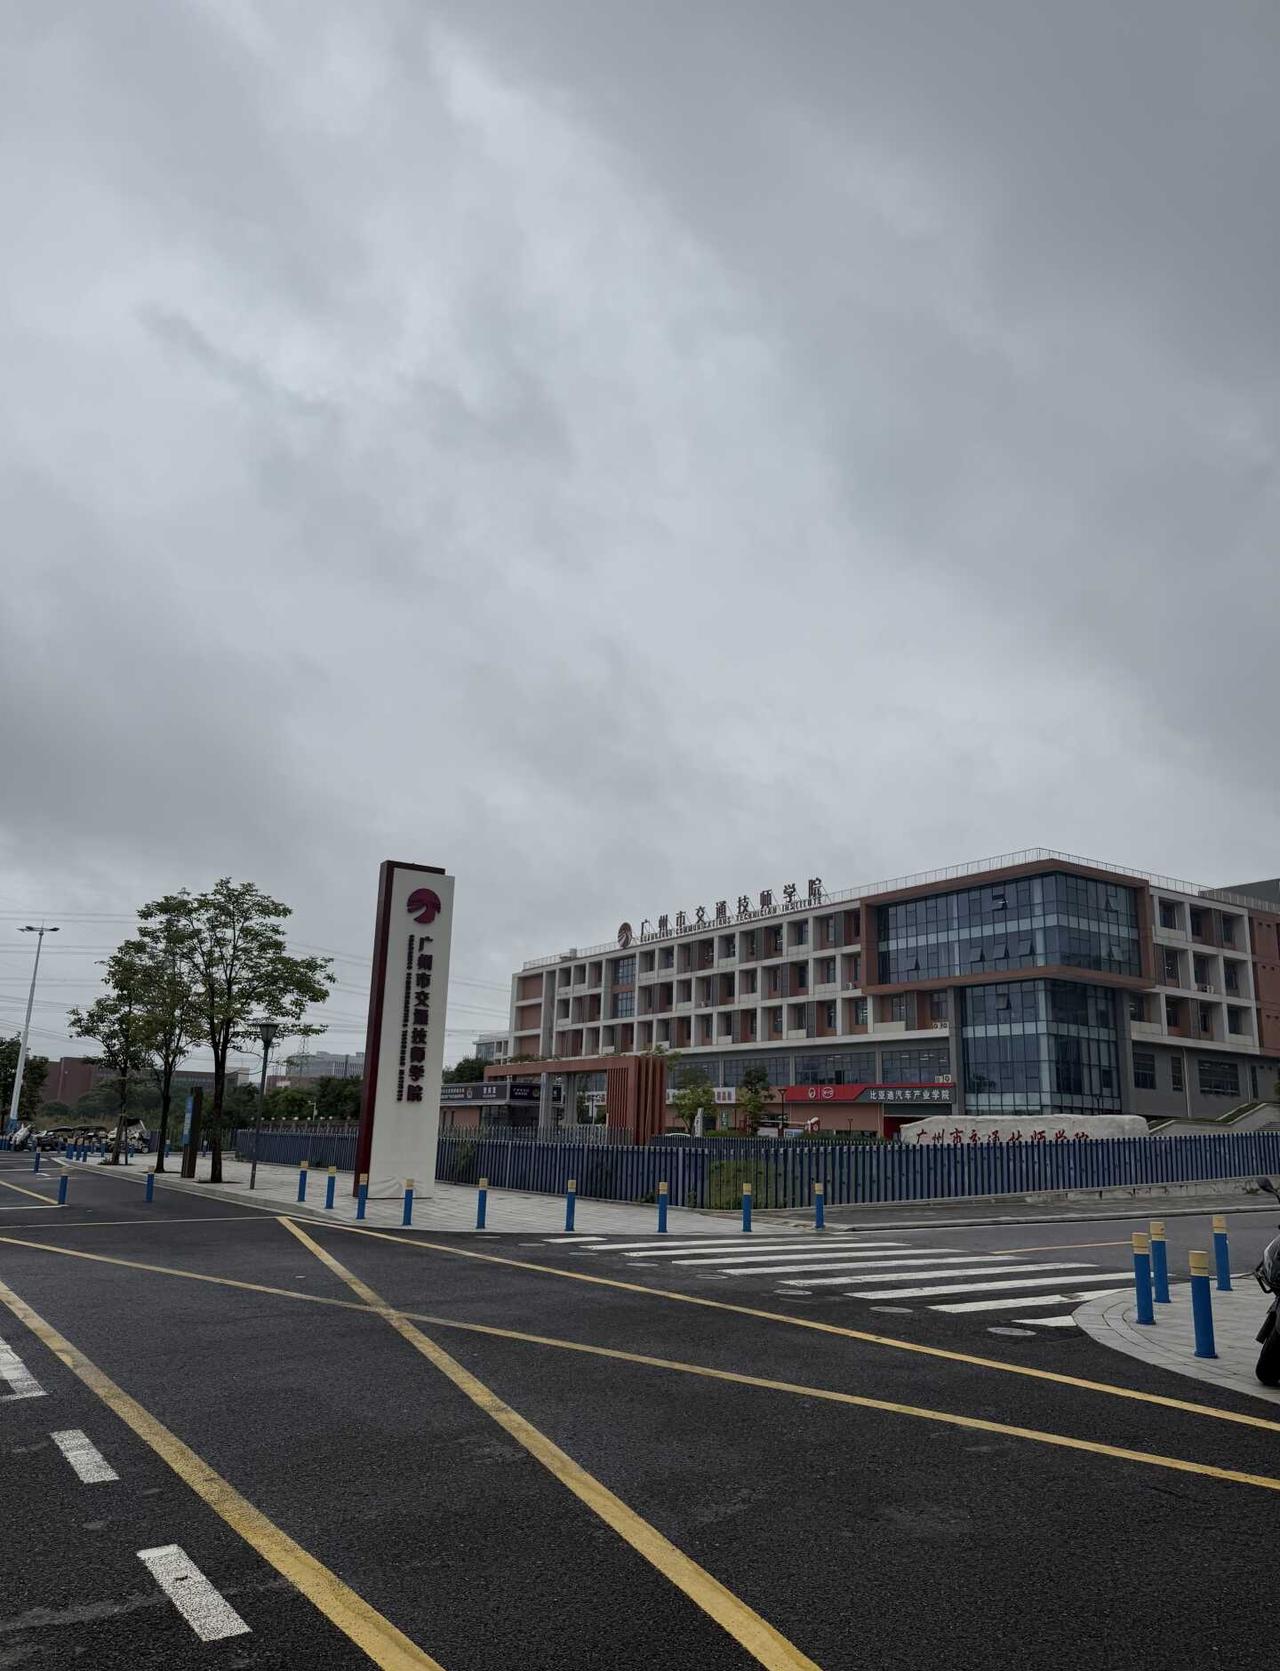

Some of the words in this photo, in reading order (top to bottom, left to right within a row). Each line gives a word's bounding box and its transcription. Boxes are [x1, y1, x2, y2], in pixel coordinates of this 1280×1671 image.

[640, 877, 822, 935] 广州市交通技师学院
[407, 936, 434, 1101] 广州市交通技师学院
[870, 1089, 950, 1100] 比亚迪汽车产业学院
